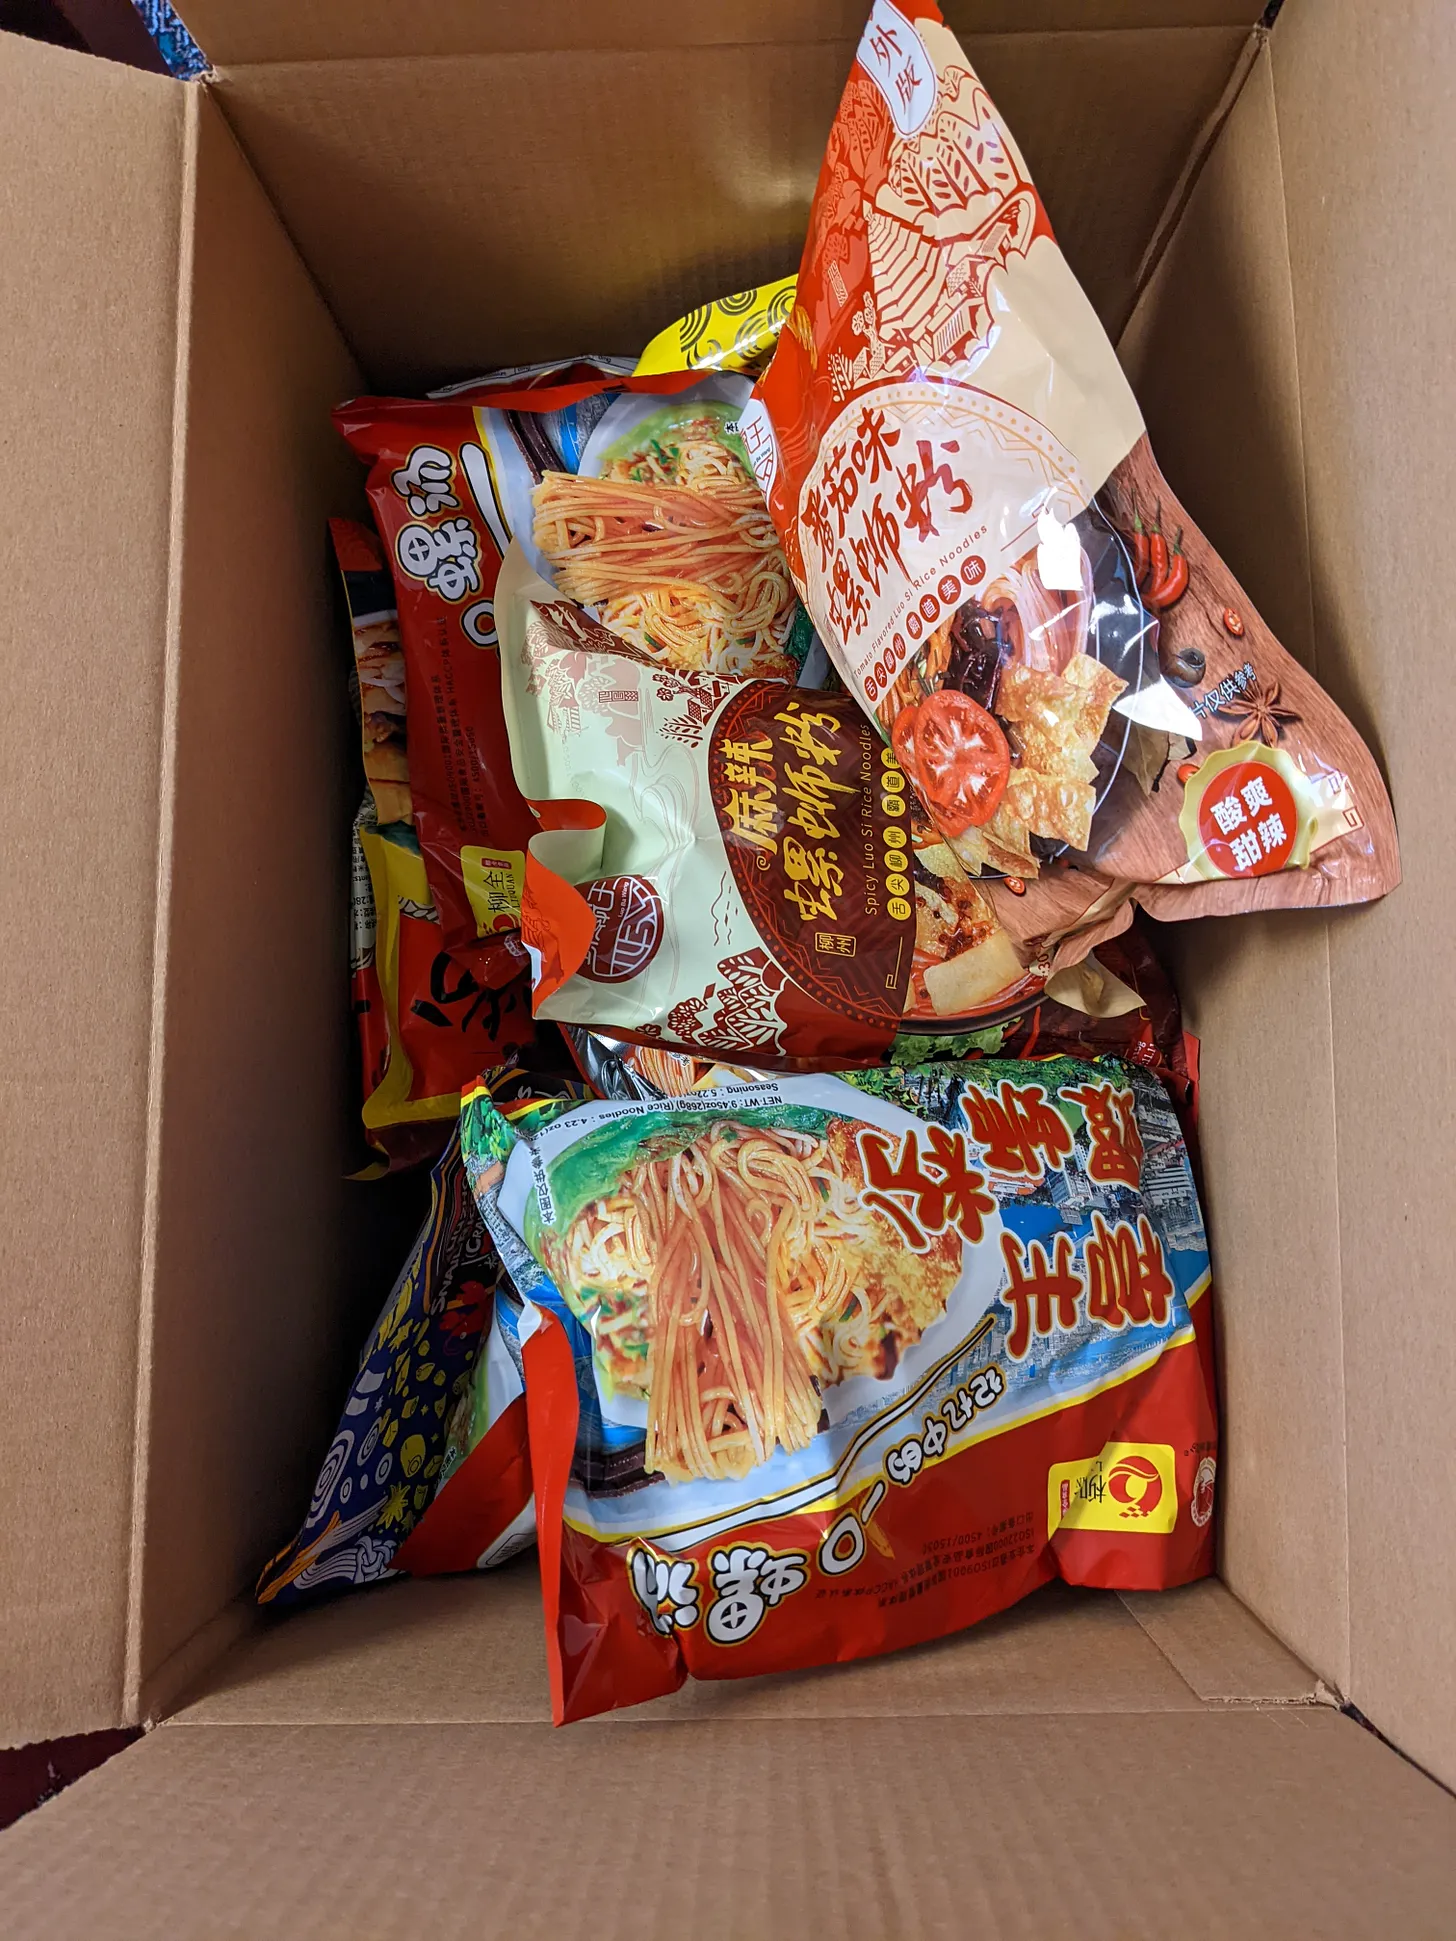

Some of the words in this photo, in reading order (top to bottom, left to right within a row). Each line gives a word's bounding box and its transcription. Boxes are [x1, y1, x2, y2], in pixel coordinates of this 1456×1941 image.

[800, 406, 901, 574] 番茄味
[854, 652, 874, 679] Tomato
[872, 616, 895, 652] Flavored
[893, 601, 907, 619] Luo
[912, 567, 937, 591] Rice
[938, 523, 989, 569] Noodles
[859, 723, 873, 782] Noodles
[721, 736, 778, 857] 麻辣
[773, 701, 862, 921] 螺蛳粉
[861, 787, 874, 822] Rice
[1210, 776, 1274, 836] 酸爽
[862, 824, 873, 838] Si
[863, 844, 875, 870] Luo
[1229, 812, 1288, 872] 甜辣
[483, 871, 508, 913] 柳全
[864, 874, 880, 916] Spicy
[884, 828, 911, 919] 舌尖柳州
[818, 934, 853, 955] 柳州
[599, 1103, 645, 1120] Noodles
[726, 1082, 779, 1096] Seasoning
[564, 1116, 588, 1130] 4.23
[861, 1081, 1145, 1250] 螺蛳粉
[1001, 1213, 1174, 1359] 柳州
